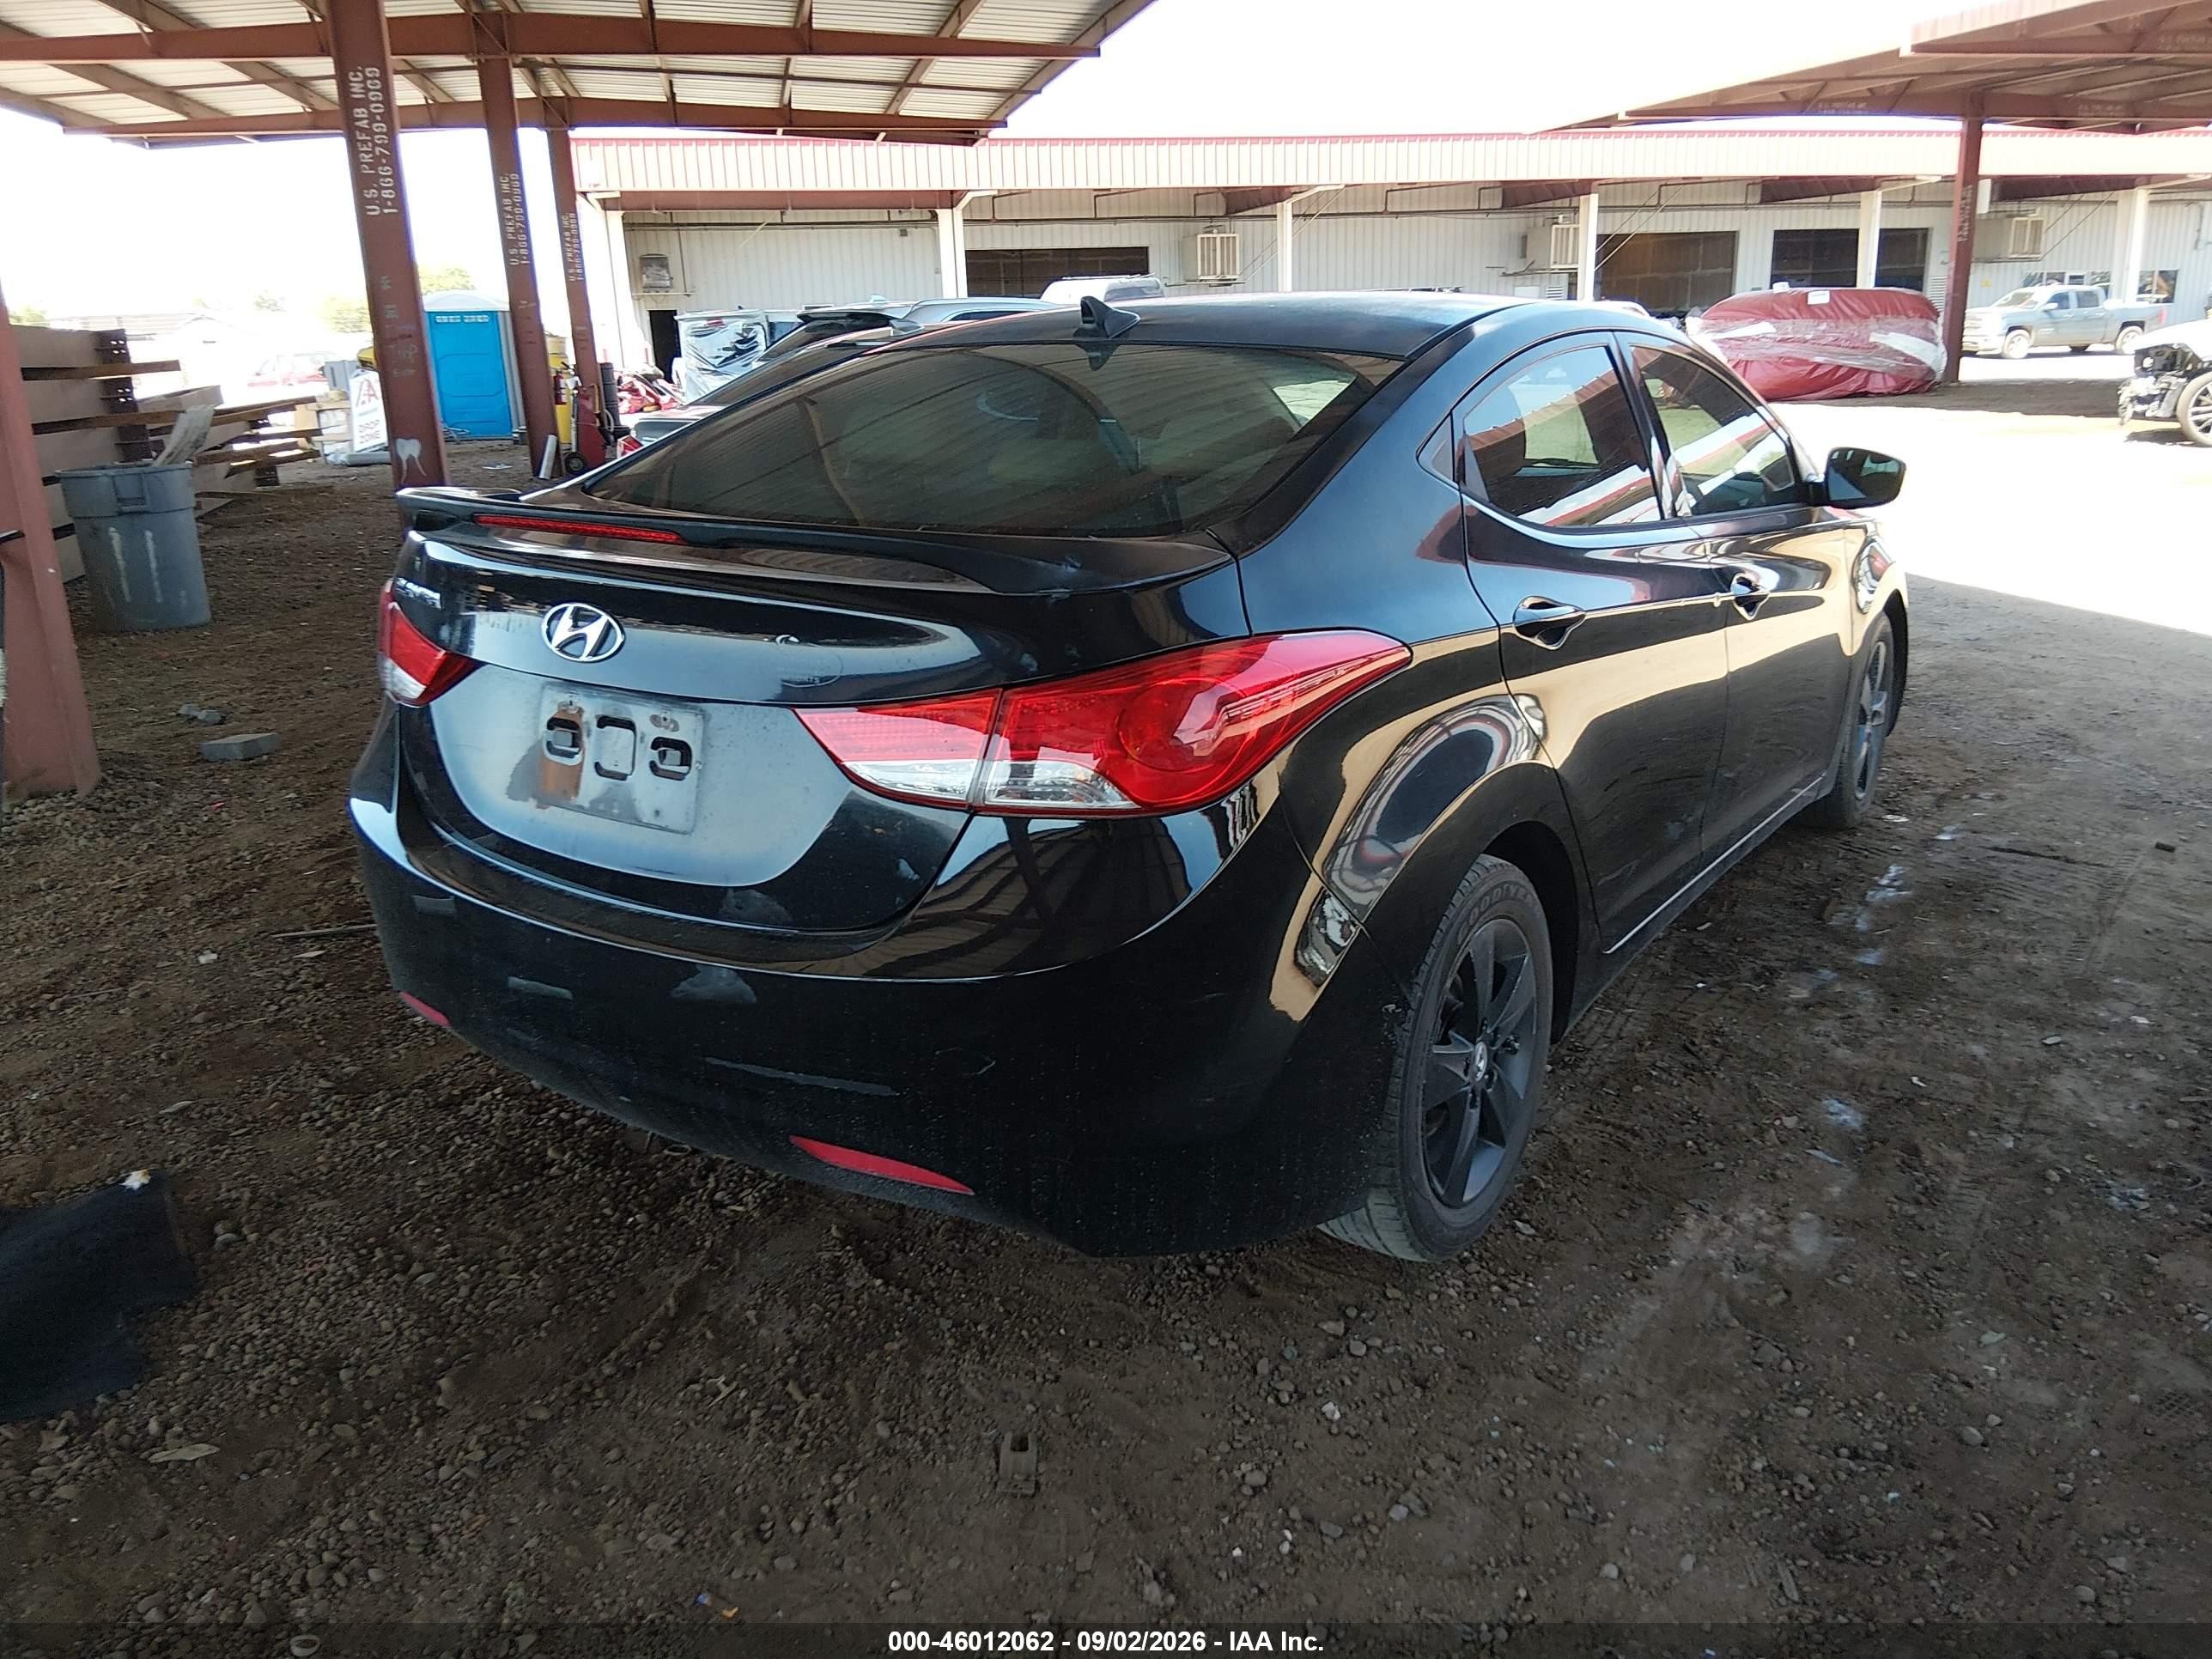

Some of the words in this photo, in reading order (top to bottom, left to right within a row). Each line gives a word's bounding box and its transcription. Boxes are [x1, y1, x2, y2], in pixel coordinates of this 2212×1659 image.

[349, 65, 366, 98] INC.
[353, 107, 375, 173] PREFAB
[364, 183, 380, 216] U.S.
[499, 173, 510, 193] INC.
[503, 198, 516, 239] PREFAB
[507, 246, 520, 265] U.S.
